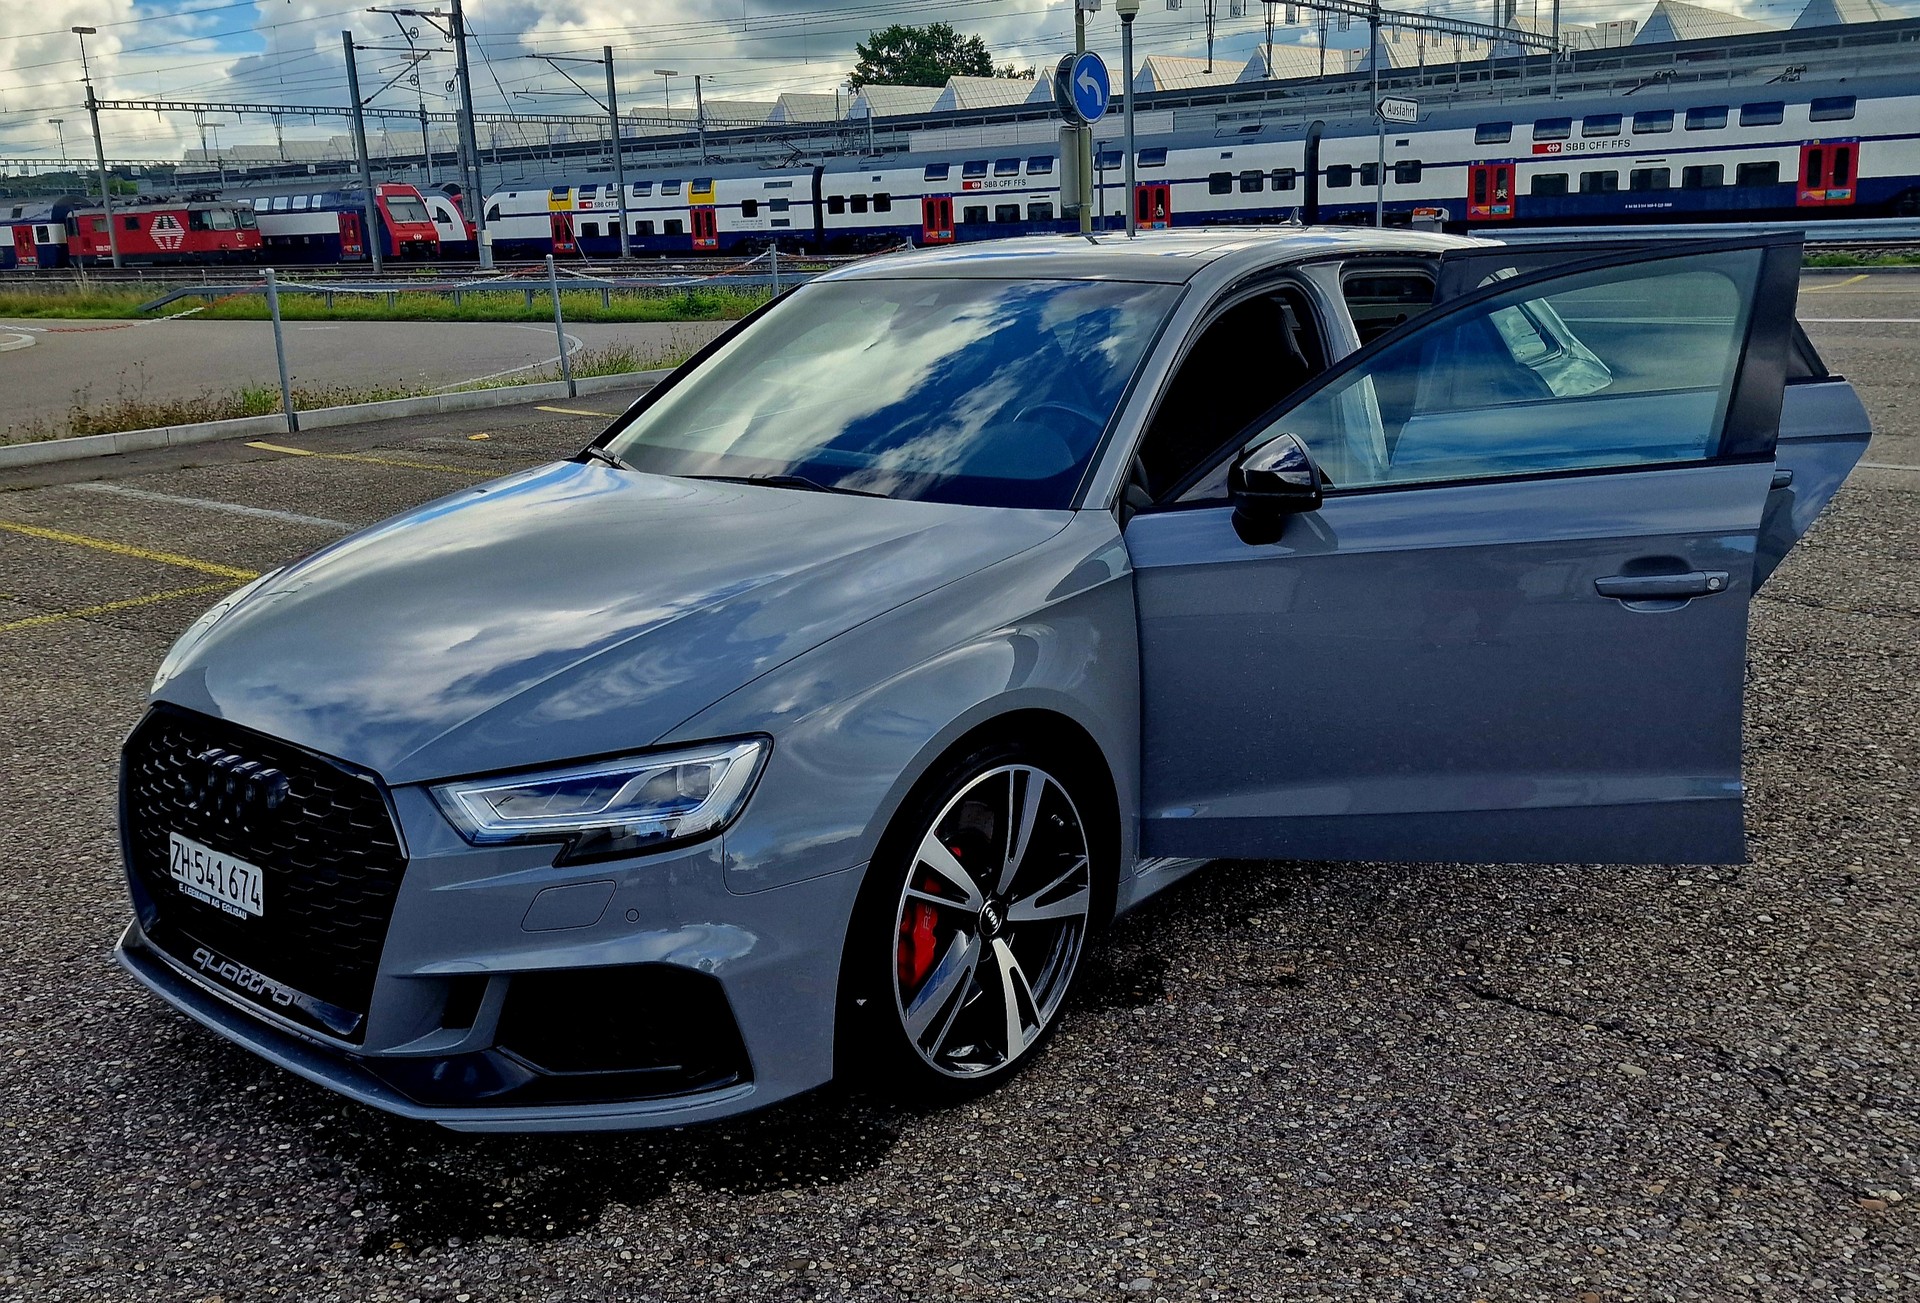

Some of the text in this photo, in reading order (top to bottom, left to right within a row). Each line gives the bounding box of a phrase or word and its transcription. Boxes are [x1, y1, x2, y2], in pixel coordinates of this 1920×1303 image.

[1387, 102, 1415, 117] Ausfahrt
[1565, 139, 1631, 151] SBB CFF FFS
[984, 178, 1027, 188] SBB CFF FFS
[192, 947, 294, 1006] quattro
